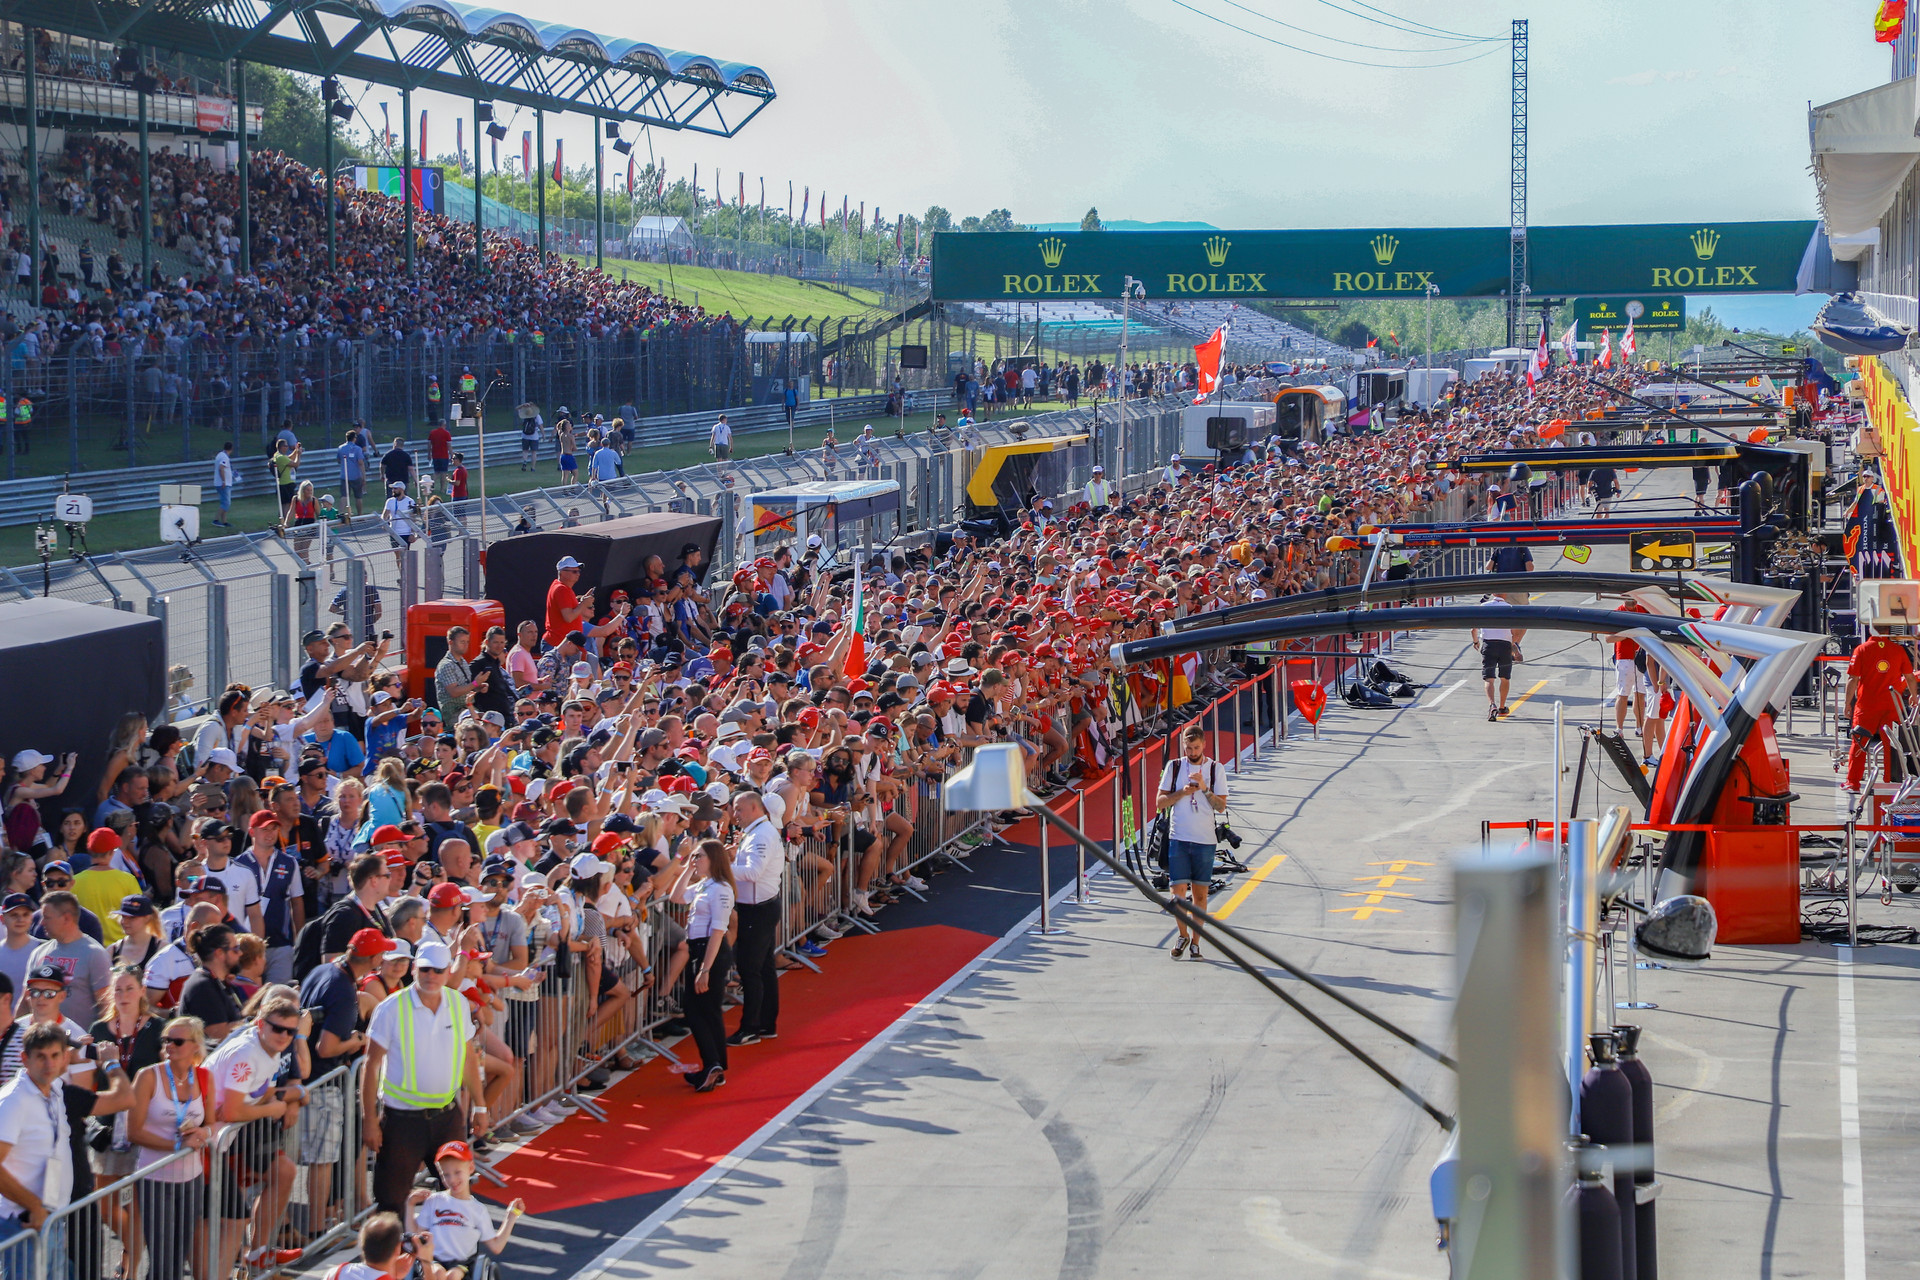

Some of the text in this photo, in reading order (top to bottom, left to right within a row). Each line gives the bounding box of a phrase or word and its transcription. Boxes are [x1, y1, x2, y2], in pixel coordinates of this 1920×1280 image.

[1002, 274, 1102, 294] ROLEX
[1166, 272, 1267, 293] ROLEX
[1333, 271, 1434, 291] ROLEX
[1651, 265, 1758, 287] ROLEX
[66, 504, 82, 515] 21
